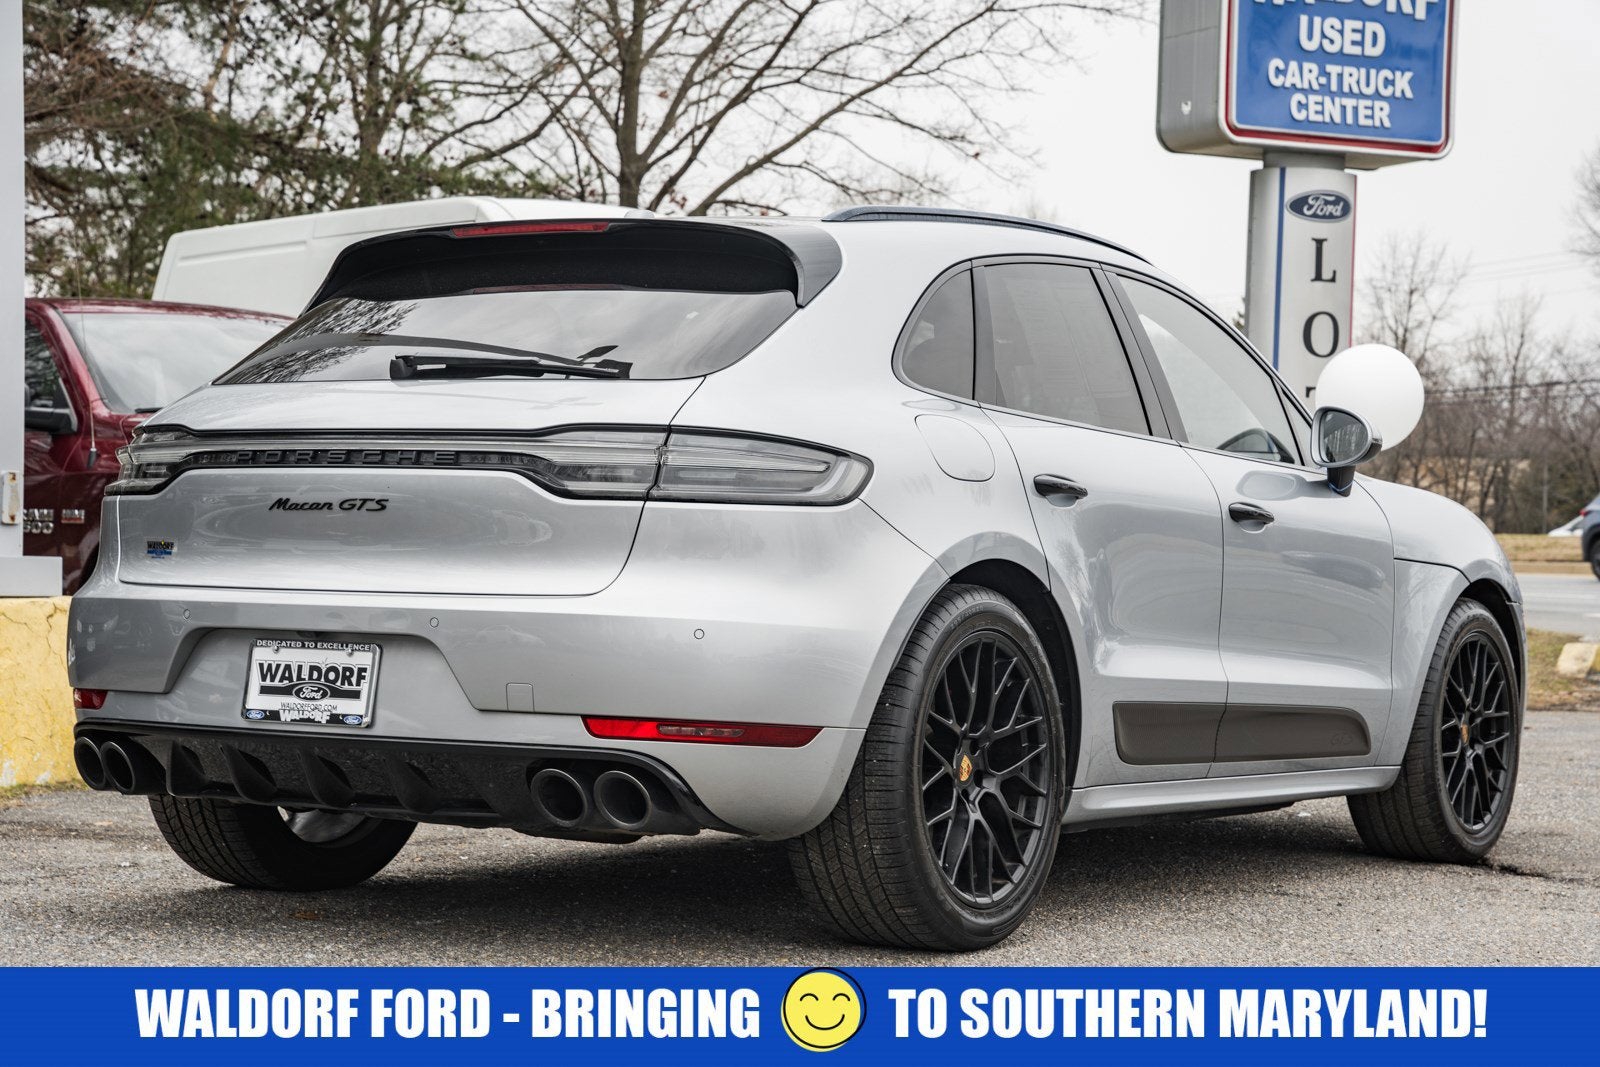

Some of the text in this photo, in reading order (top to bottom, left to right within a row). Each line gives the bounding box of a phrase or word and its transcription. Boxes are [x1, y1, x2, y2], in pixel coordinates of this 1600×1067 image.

[1299, 14, 1387, 58] USED
[1267, 57, 1414, 99] CAR-TRUCK
[1289, 93, 1391, 128] CENTER
[1302, 194, 1344, 217] Ford
[1302, 237, 1340, 398] LO
[236, 450, 457, 465] PORSCHE
[268, 497, 389, 512] Macan GTS
[256, 640, 302, 648] DEDICATED
[317, 643, 370, 651] EXCELLENCE
[258, 662, 368, 687] WALDORF
[299, 685, 323, 700] Ford
[279, 709, 331, 724] WALDORF
